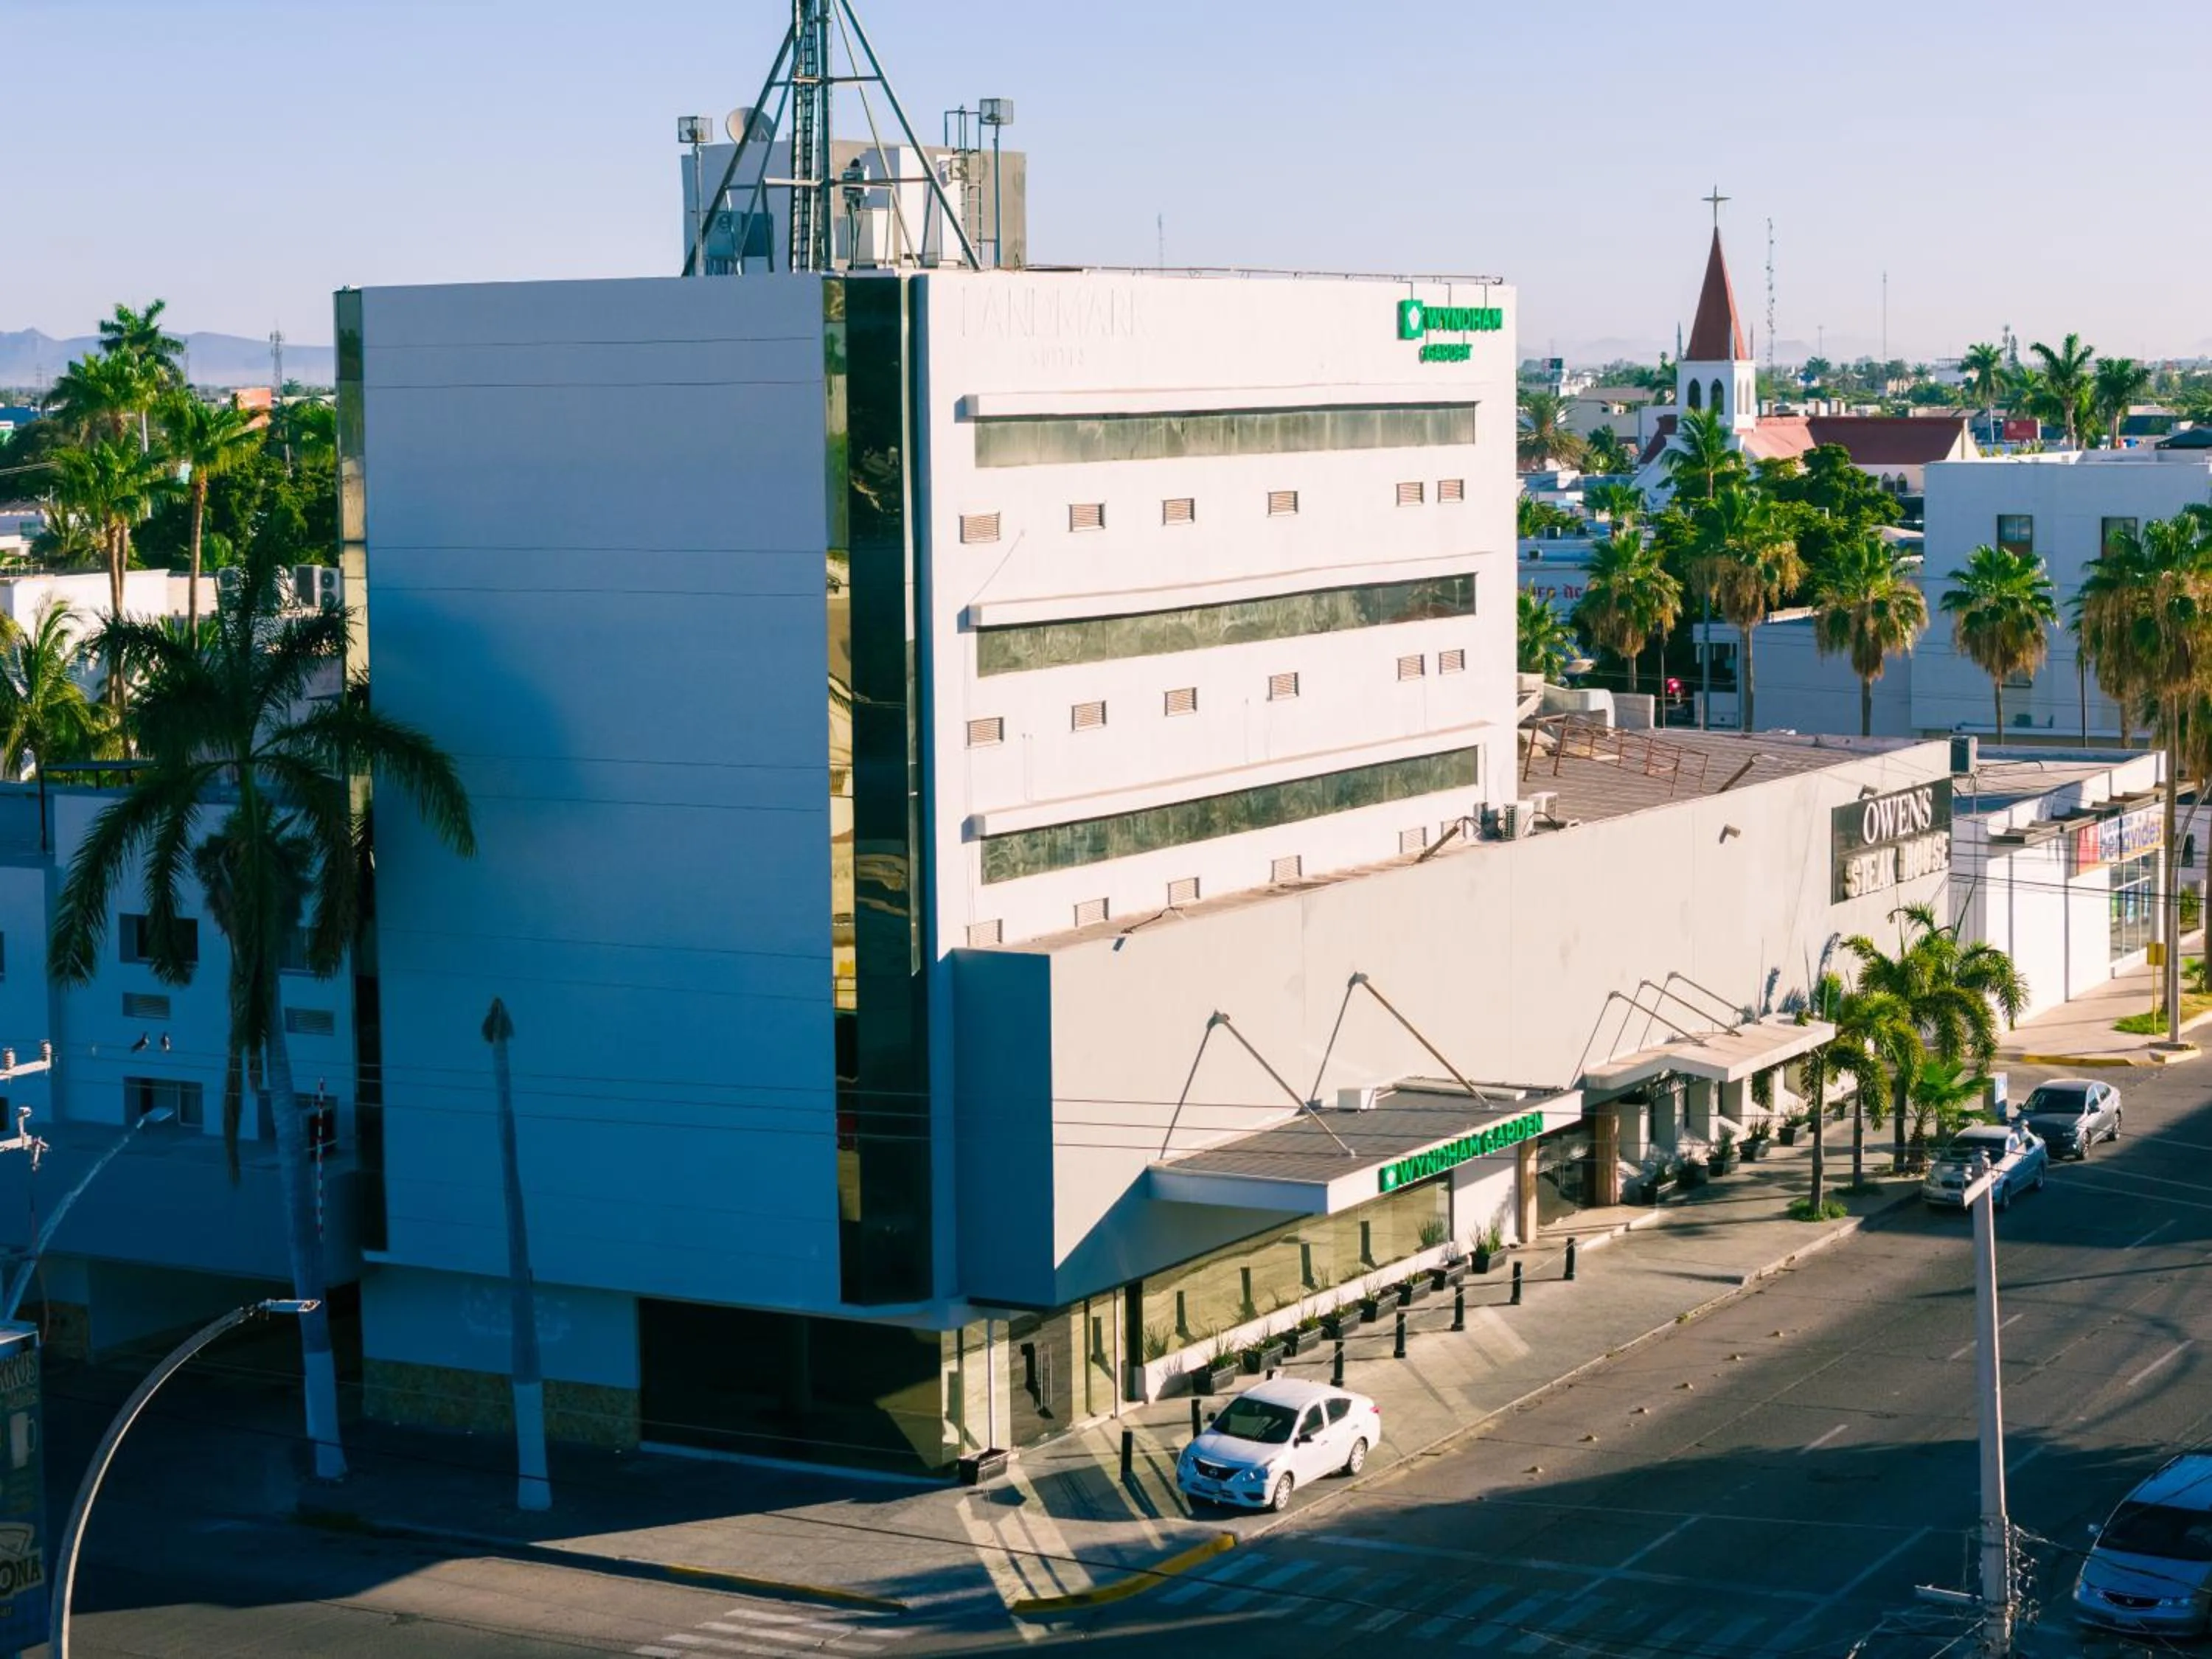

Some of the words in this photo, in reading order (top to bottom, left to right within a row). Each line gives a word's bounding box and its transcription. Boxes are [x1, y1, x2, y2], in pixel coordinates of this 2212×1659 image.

[1425, 307, 1502, 330] WYNDHAM
[1423, 344, 1472, 361] GARDEN
[1863, 787, 1933, 845] OWENS
[1845, 846, 1896, 898] STEAK
[1898, 830, 1950, 882] HOUSE
[1398, 1133, 1481, 1183] WYNDHAM
[1481, 1110, 1544, 1153] GARDEN
